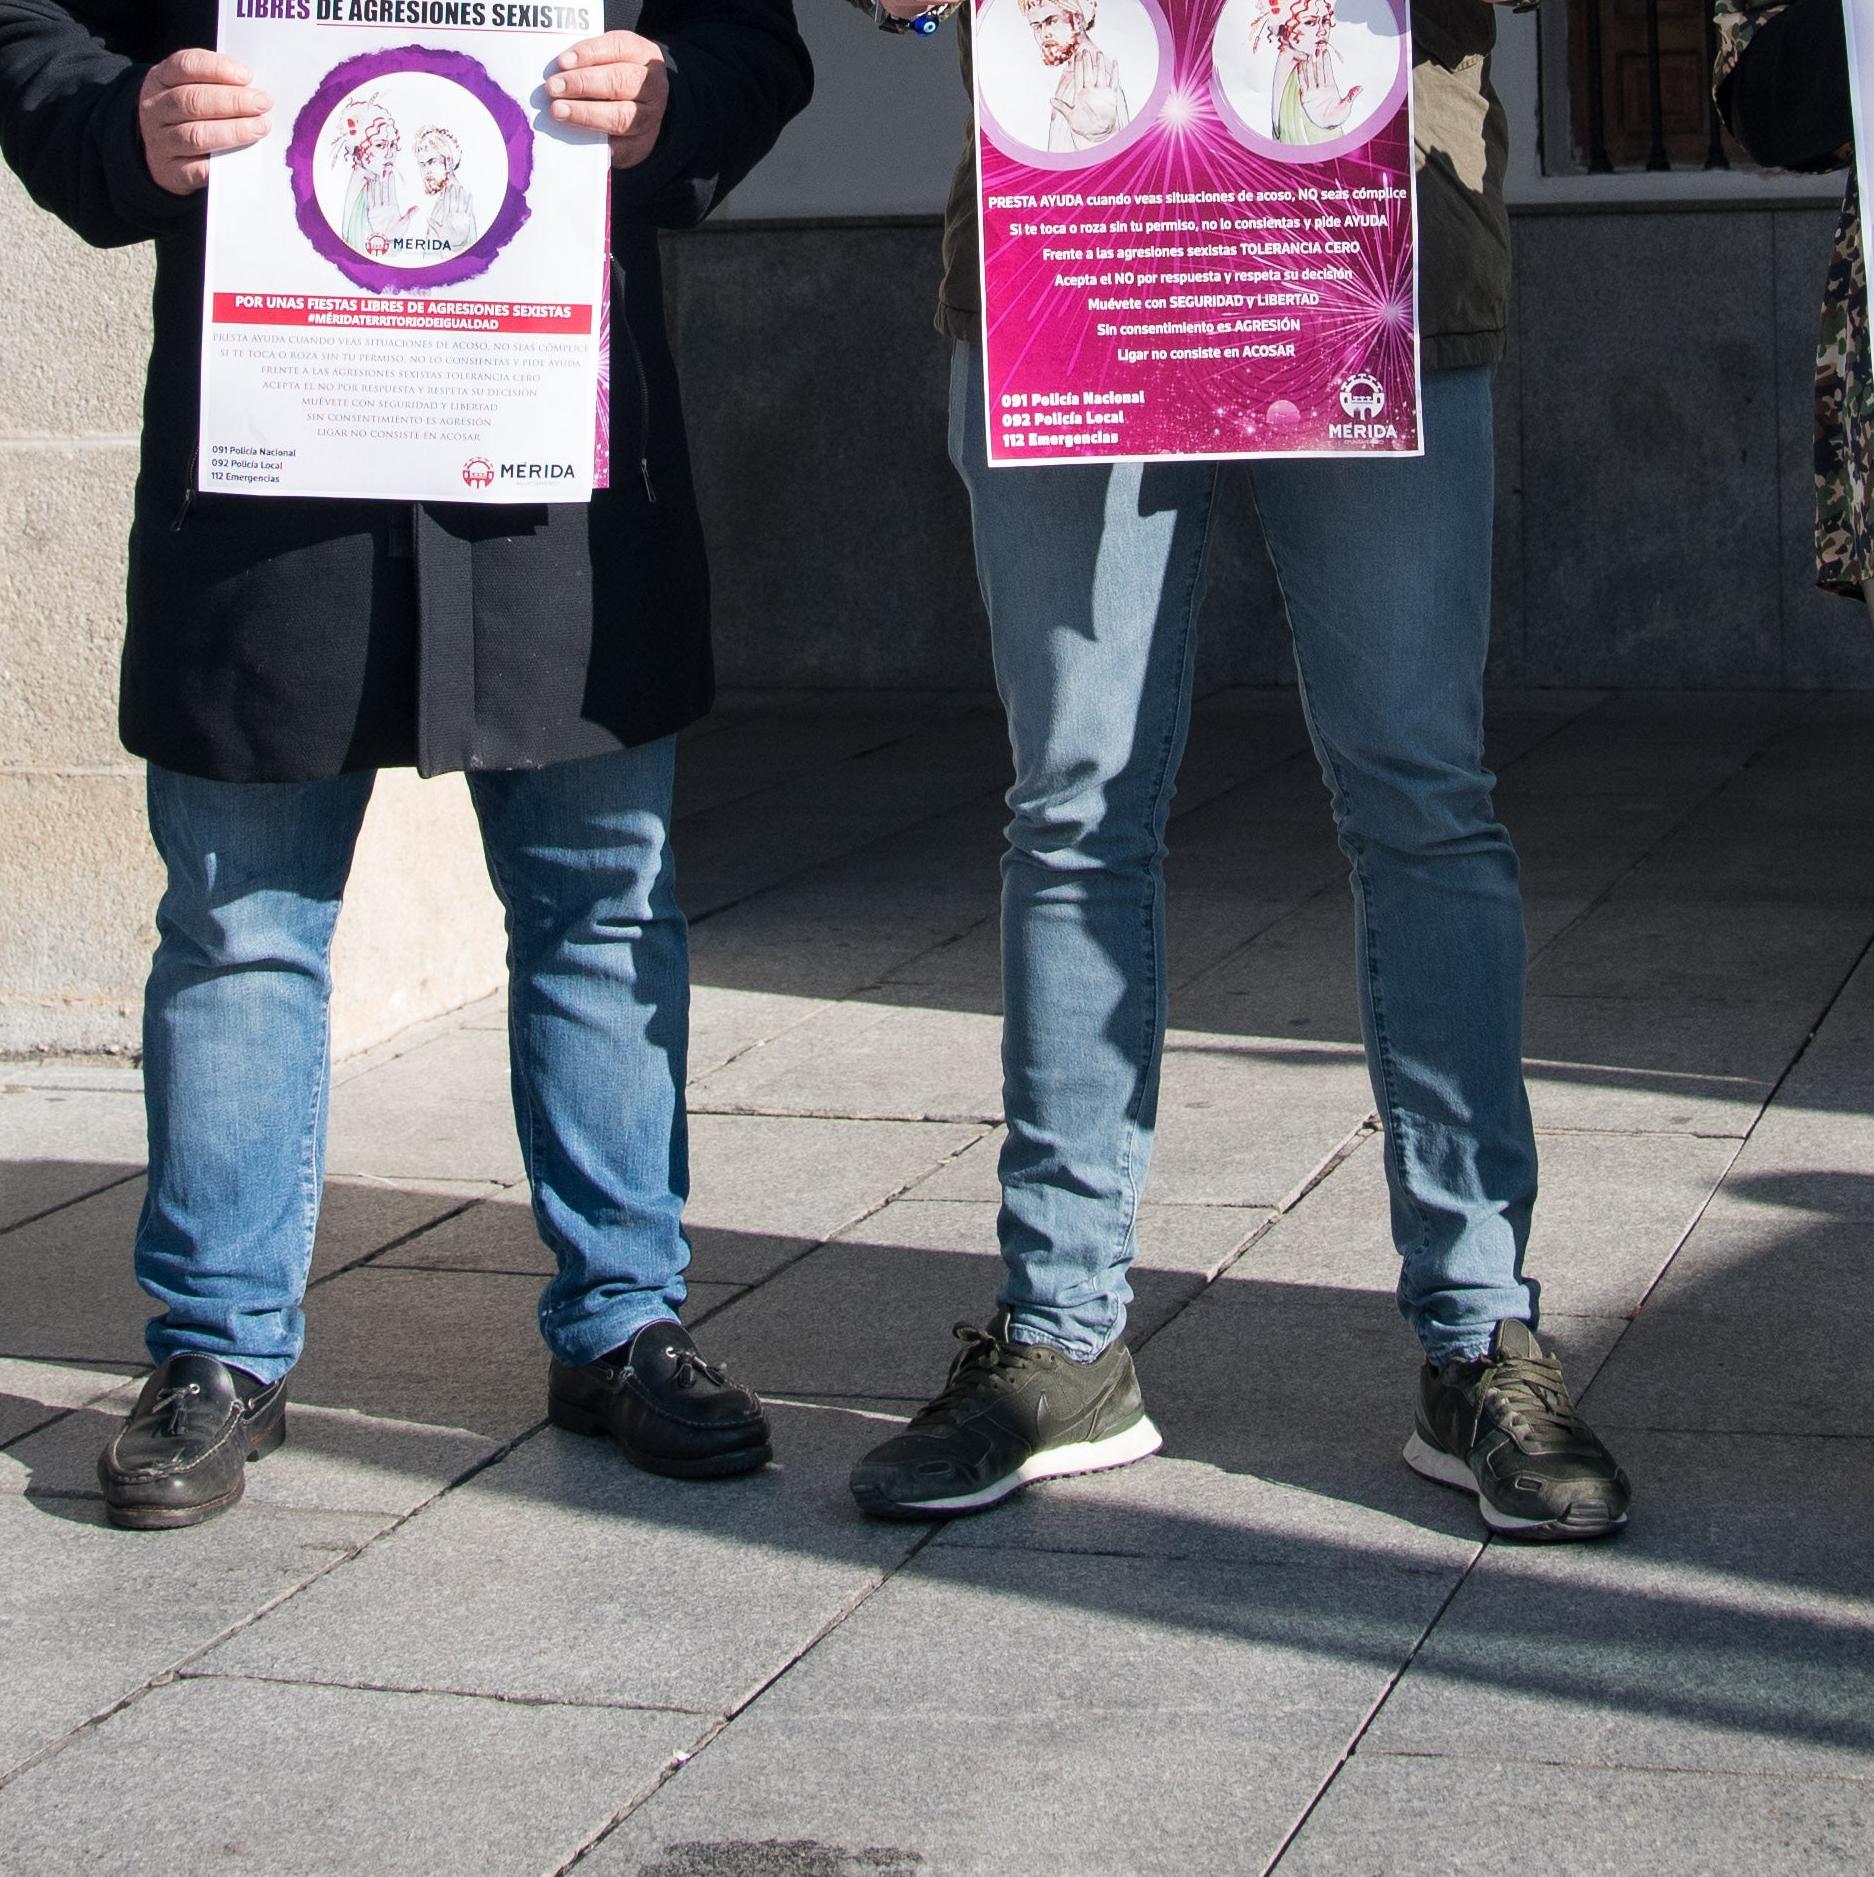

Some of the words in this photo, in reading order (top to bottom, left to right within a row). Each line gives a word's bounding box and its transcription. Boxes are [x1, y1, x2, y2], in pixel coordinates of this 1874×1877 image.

[348, 0, 485, 26] AGRESIONES
[492, 3, 590, 30] SEXISTAS
[1118, 349, 1149, 363] Ligar
[1152, 350, 1167, 359] no
[1170, 347, 1221, 359] consiste
[1224, 348, 1239, 357] en
[1243, 343, 1295, 357] ACOSAR
[1032, 392, 1079, 406] Policía
[1083, 391, 1144, 404] Nacional
[1035, 412, 1082, 426] Policía
[1086, 411, 1124, 424] Local
